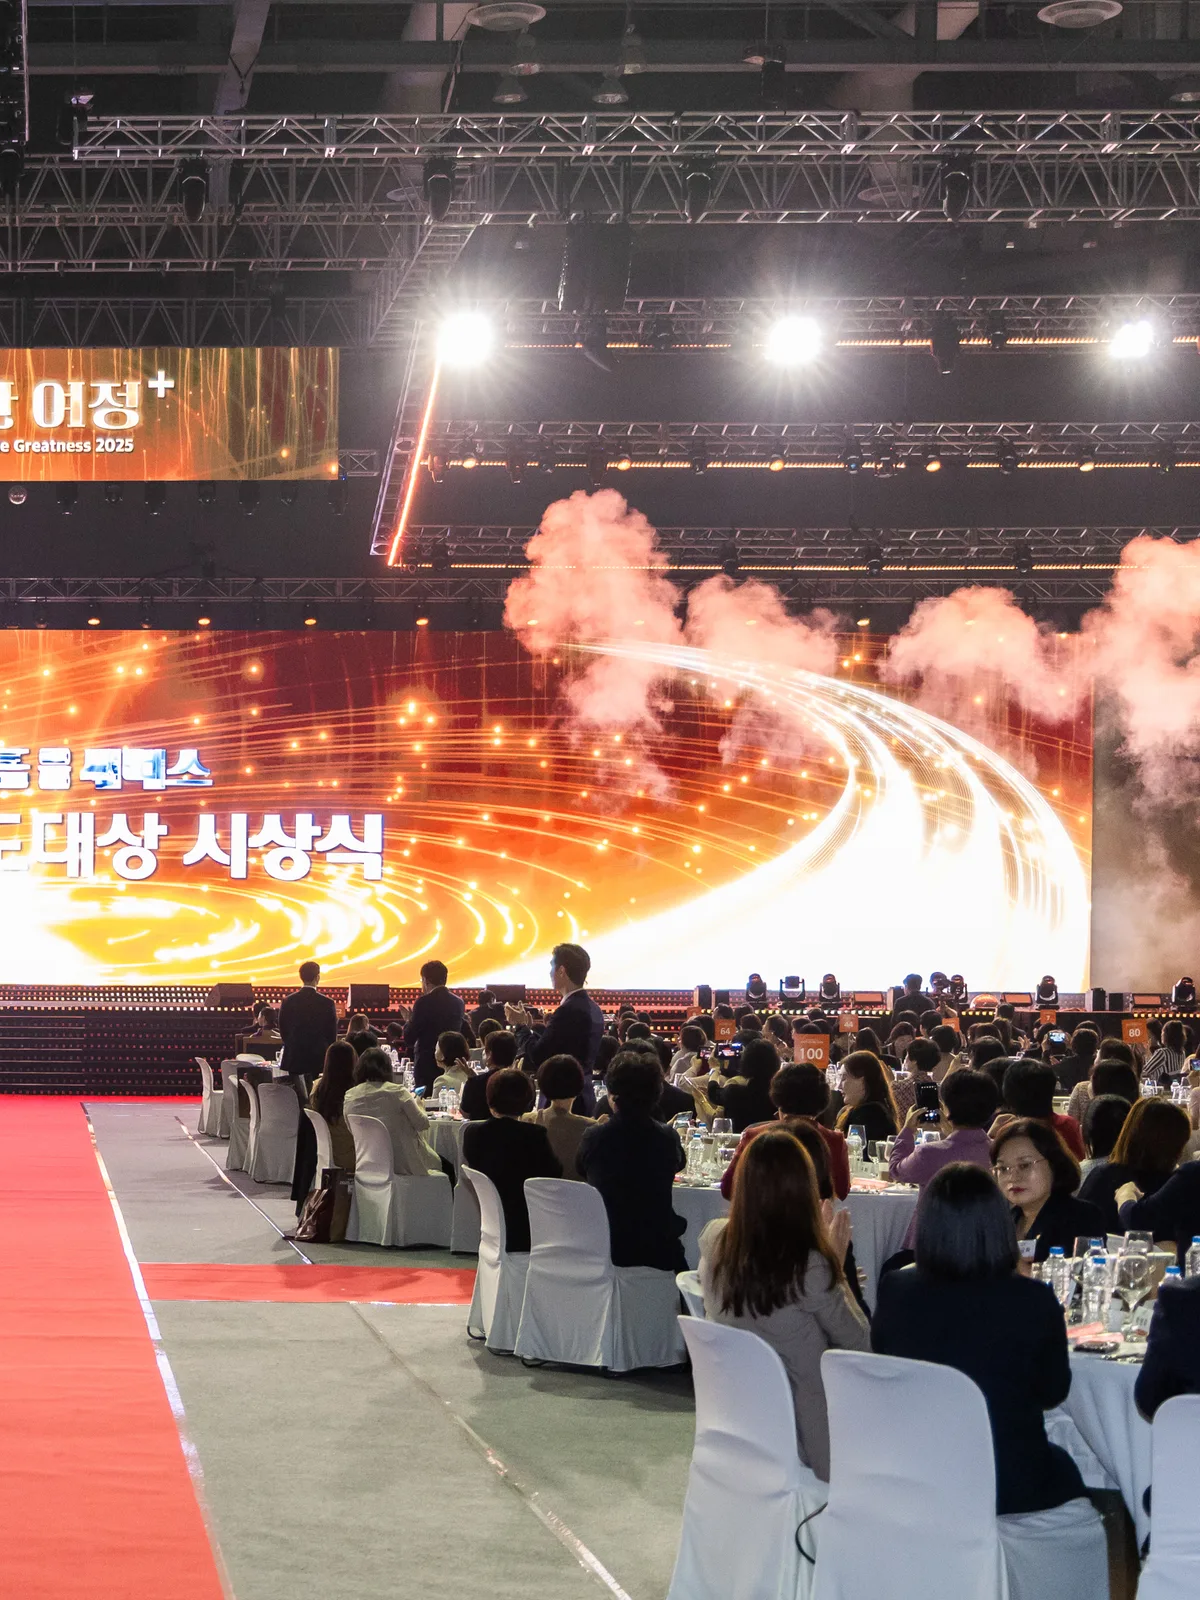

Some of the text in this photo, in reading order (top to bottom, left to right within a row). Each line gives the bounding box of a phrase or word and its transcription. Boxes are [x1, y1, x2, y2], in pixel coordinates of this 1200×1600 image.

[13, 438, 92, 454] Greatness
[95, 438, 134, 454] 2025
[182, 811, 383, 882] 시상식
[720, 1027, 731, 1036] 64
[1128, 1028, 1141, 1037] 80
[799, 1047, 824, 1060] 100
